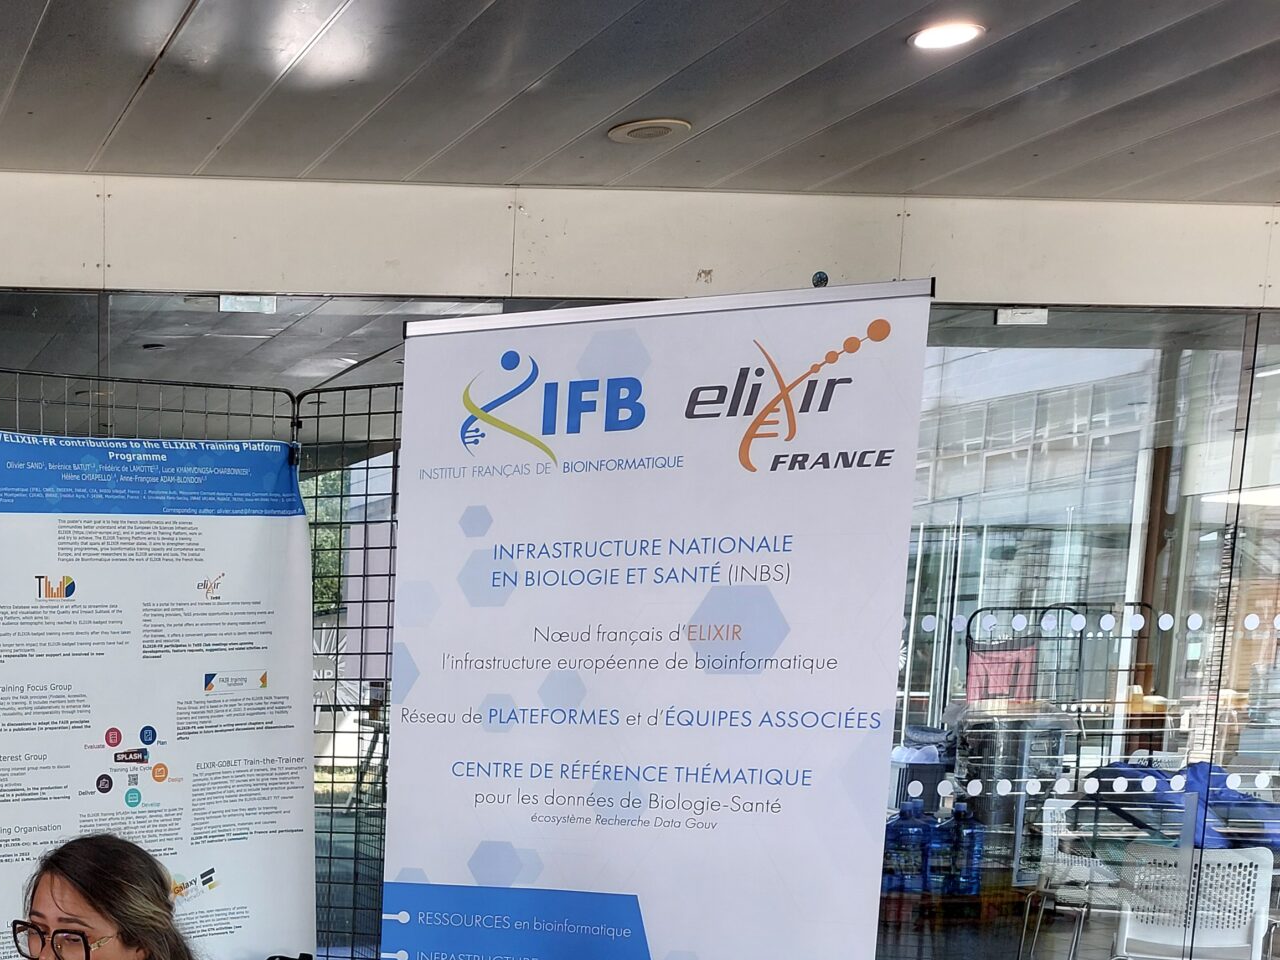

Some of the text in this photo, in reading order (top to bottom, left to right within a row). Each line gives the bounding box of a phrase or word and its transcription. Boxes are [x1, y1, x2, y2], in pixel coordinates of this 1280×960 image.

[541, 349, 853, 446] IFB elixir
[59, 438, 128, 449] contributions
[130, 441, 141, 449] to
[143, 441, 160, 449] the
[163, 442, 197, 451] ELIXIR
[200, 442, 240, 452] Training
[243, 442, 281, 452] Platform
[6, 461, 25, 470] Olivier
[108, 452, 167, 463] Programme
[419, 455, 684, 480] INSTITUT FRANÇAIS DE BIOINFORMATIQUE
[770, 449, 895, 471] FRANCE
[162, 506, 197, 515] Corresponding
[493, 535, 793, 560] INFRASTRUCTURE NATIONALE
[492, 561, 791, 587] EN BIOLOGIE ET SANTÉ (INBS)
[533, 624, 743, 646] Nœud français d'ELIXIR
[442, 650, 838, 675] l'infrastructure européenne de bioinformatique
[27, 684, 48, 692] Focus
[50, 683, 72, 692] Group
[401, 705, 881, 729] Réseau de PLATEFORMES et d'ÉQUIPES ASSOCIÉES
[25, 753, 47, 762] Group
[116, 753, 142, 761] SPLASH
[196, 756, 304, 770] ELIXIR-GOBLET Train-the-Trainer
[451, 760, 813, 787] CENTRE DE RÉFÉRENCE THÉMATIQUE
[474, 788, 782, 816] pour les données de Biologie-Santé
[14, 824, 62, 834] Organisation
[530, 813, 718, 830] écosystème Recherche Data Gouv
[418, 911, 632, 941] RESSOURCES en bioinformatique
